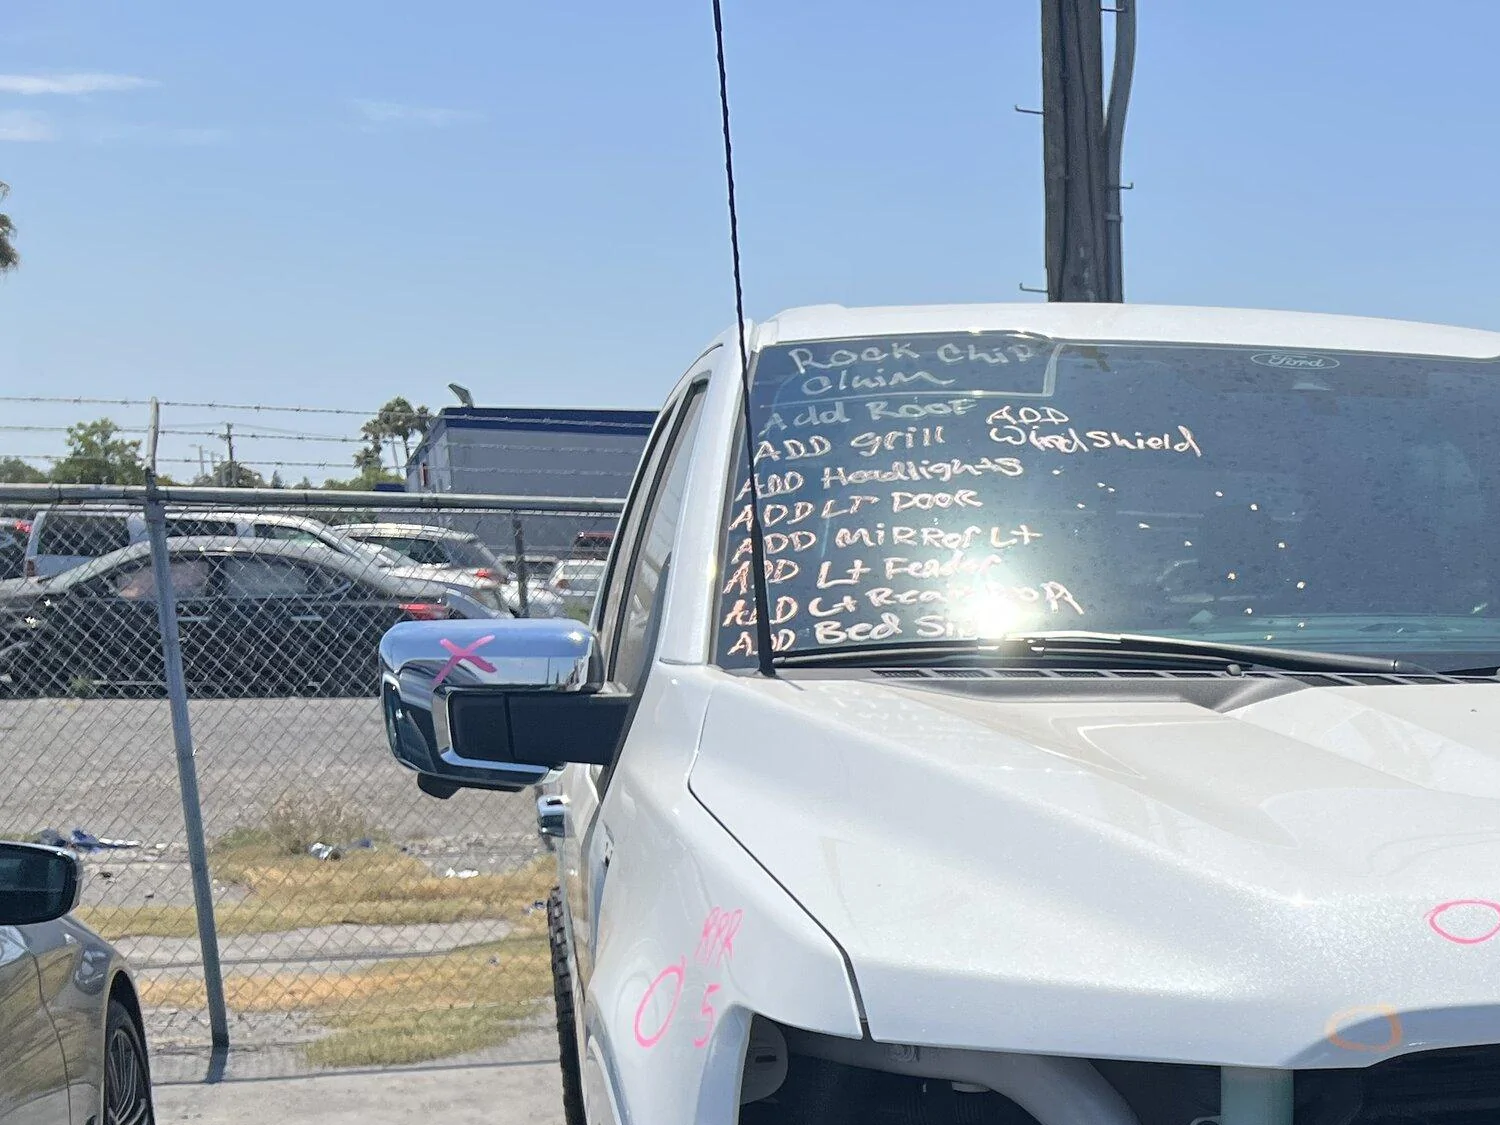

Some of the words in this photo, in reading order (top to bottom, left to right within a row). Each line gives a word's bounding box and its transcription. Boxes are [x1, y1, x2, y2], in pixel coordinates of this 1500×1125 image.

[1267, 354, 1325, 367] Ford
[985, 405, 1070, 425] ADD
[752, 435, 832, 467] ADD
[734, 470, 806, 502] ADD
[728, 501, 816, 532] ADD
[730, 530, 817, 565] ADD
[722, 595, 799, 627] AD
[813, 612, 904, 645] Bed
